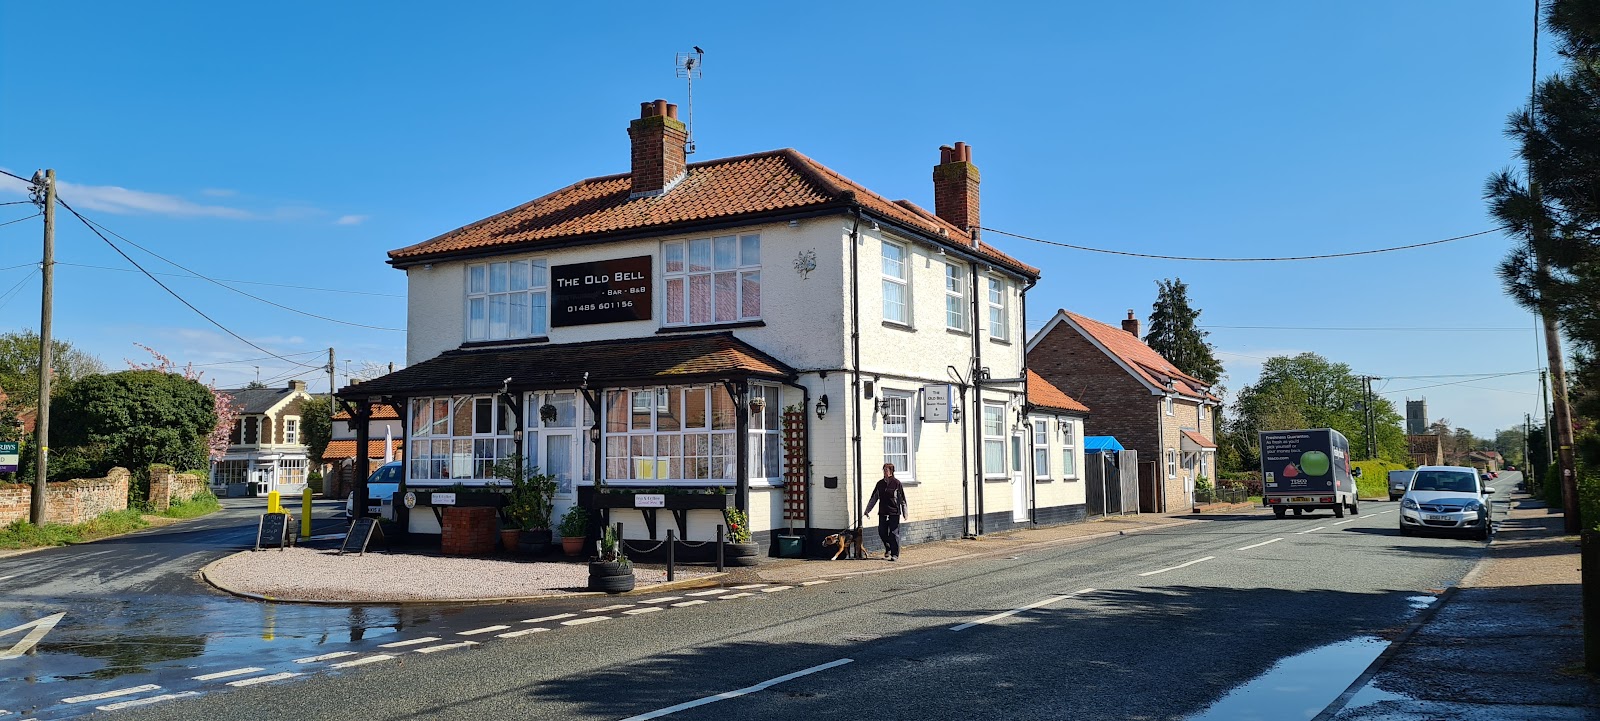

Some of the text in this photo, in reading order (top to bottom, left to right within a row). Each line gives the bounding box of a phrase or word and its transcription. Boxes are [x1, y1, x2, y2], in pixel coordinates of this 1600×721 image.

[557, 272, 644, 287] THE OLD BELL
[568, 301, 633, 313] 01485 601156
